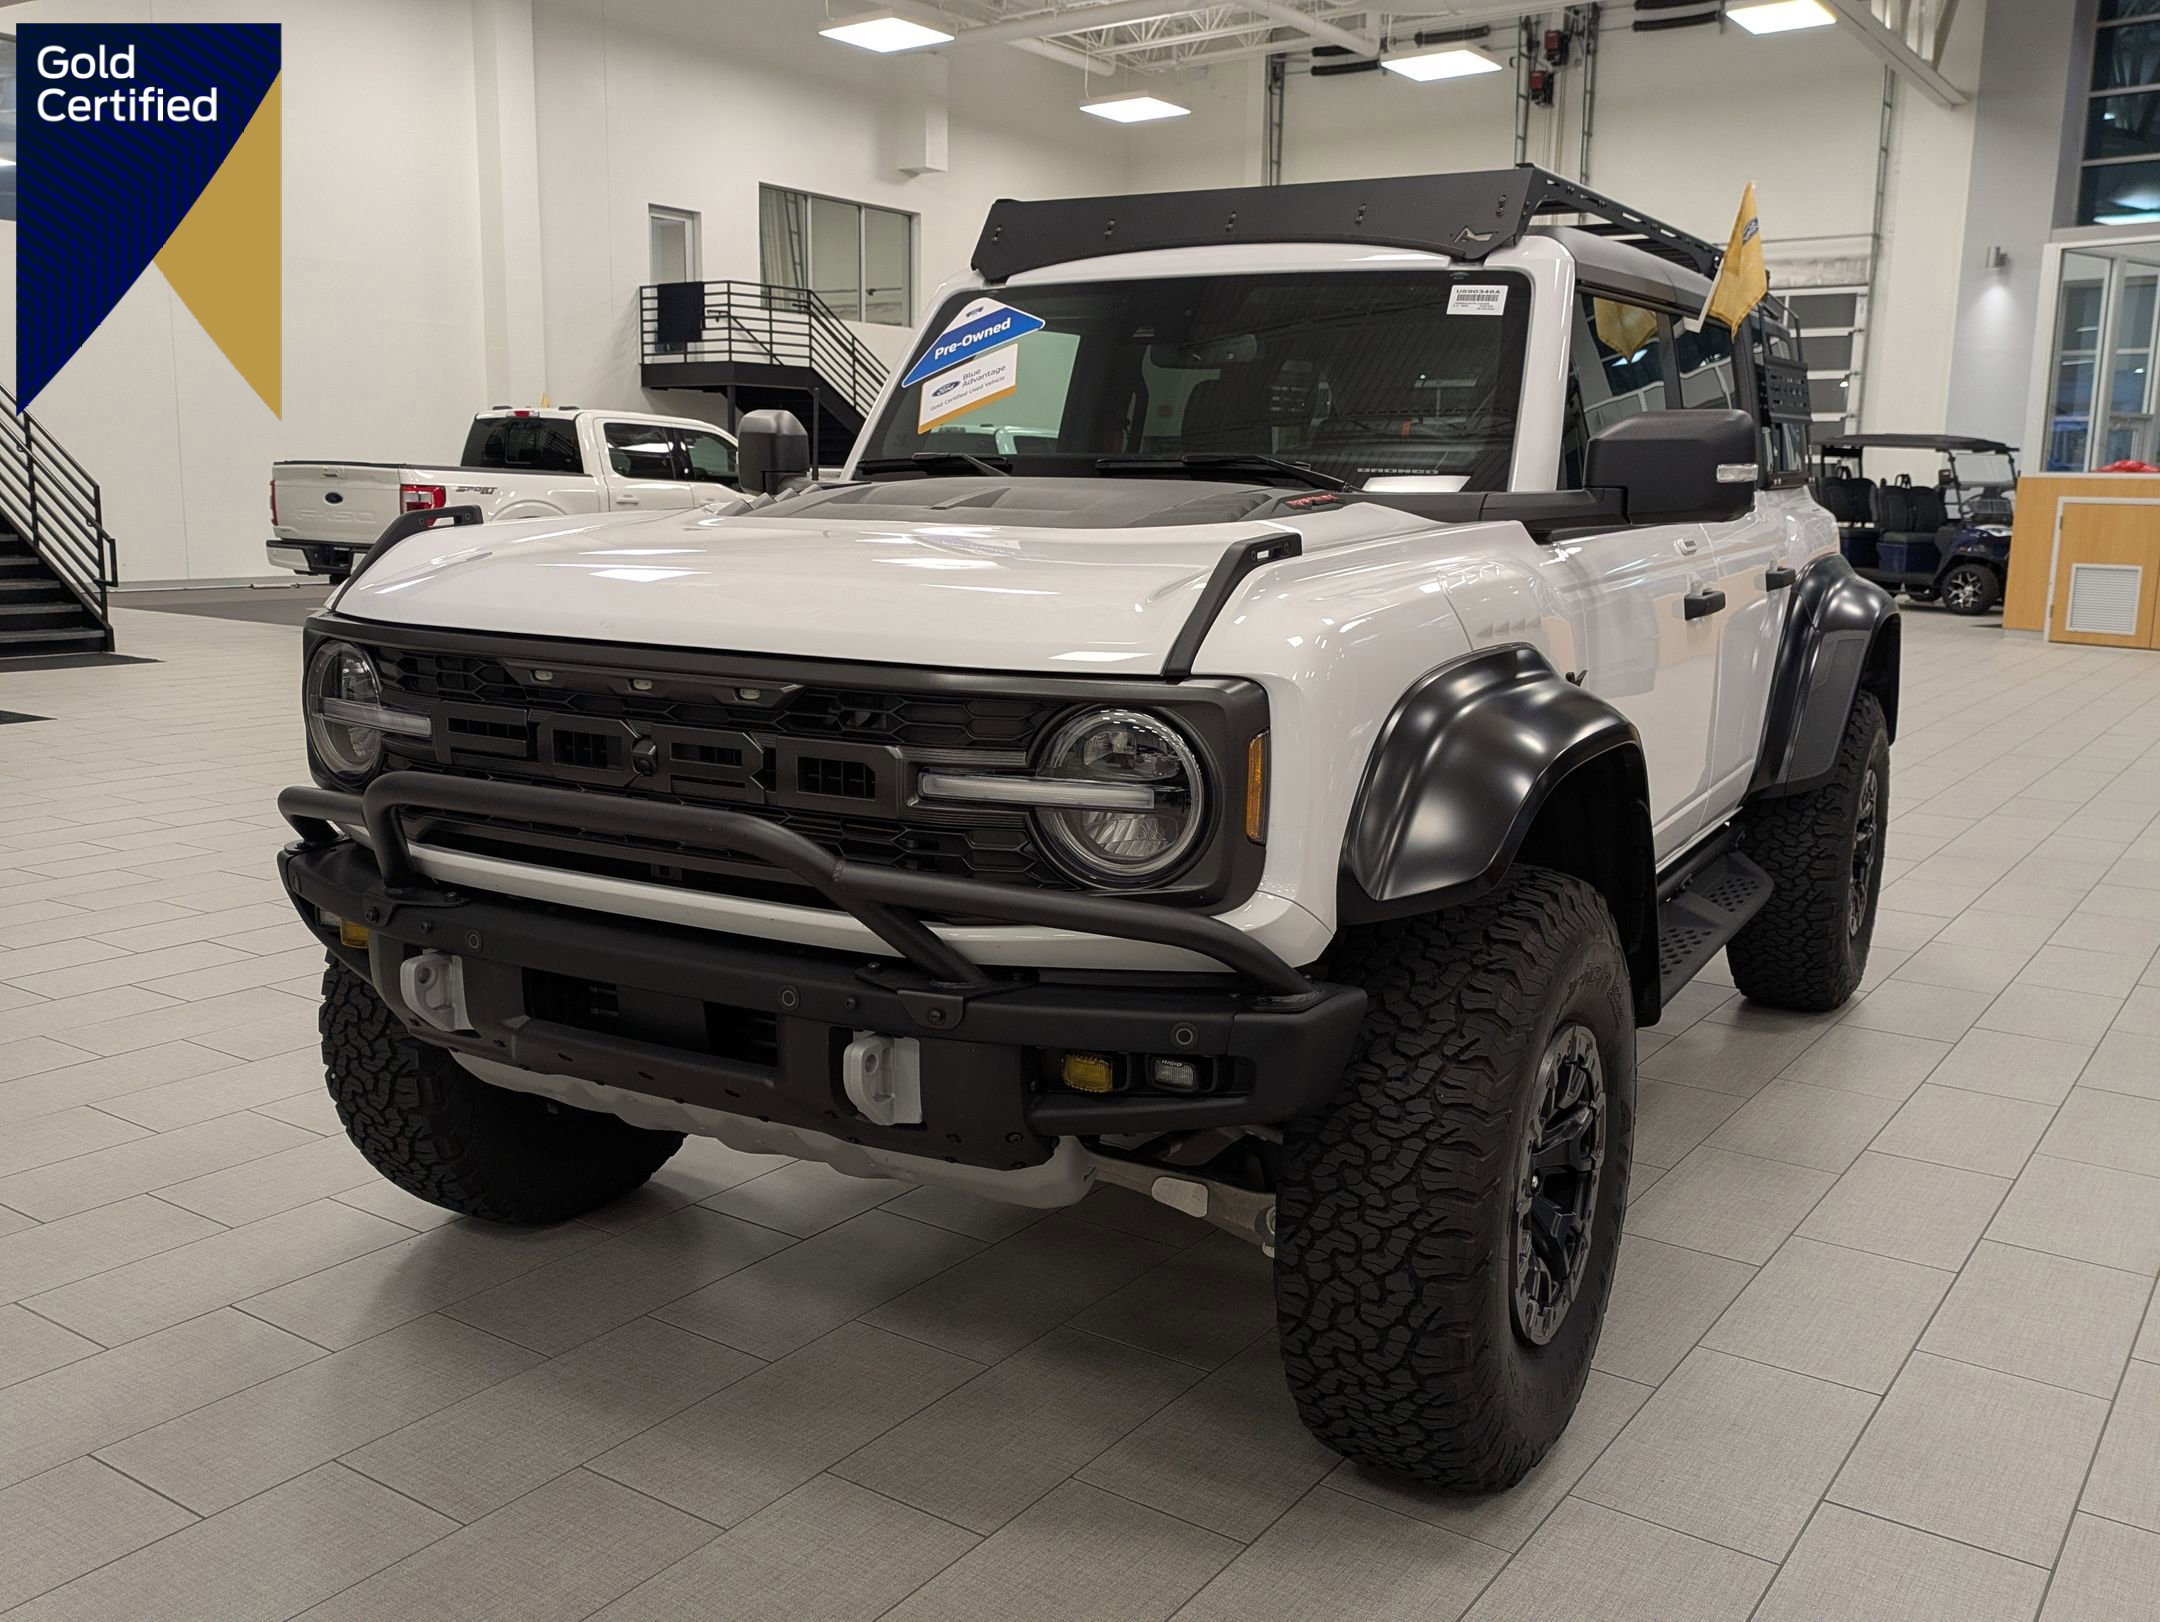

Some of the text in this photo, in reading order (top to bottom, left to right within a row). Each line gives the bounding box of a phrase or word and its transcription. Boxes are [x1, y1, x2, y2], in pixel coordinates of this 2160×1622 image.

[934, 317, 1012, 360] Pre-Owned
[962, 368, 982, 381] Blue
[962, 365, 1007, 388] Advantage
[432, 701, 901, 818] FORD
